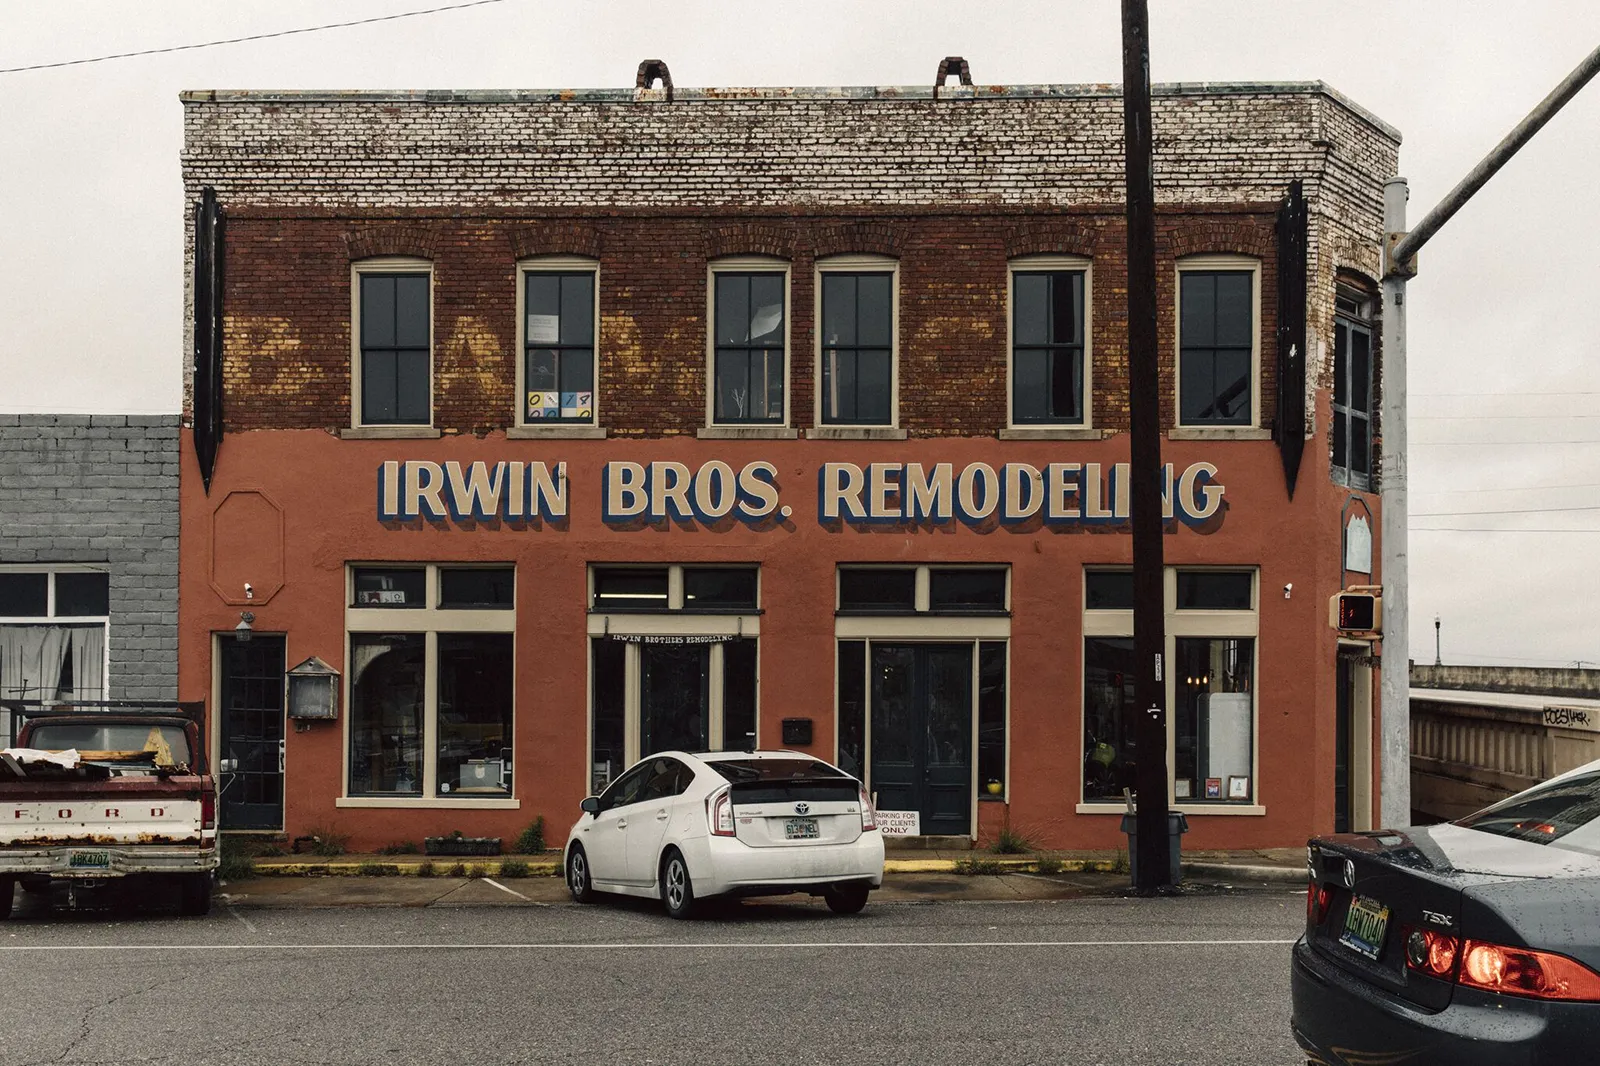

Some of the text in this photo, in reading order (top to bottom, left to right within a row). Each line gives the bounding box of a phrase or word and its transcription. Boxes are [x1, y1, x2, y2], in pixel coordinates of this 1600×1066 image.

[378, 460, 569, 523] IRWIN
[602, 459, 794, 526] BROS.
[612, 634, 734, 644] IRWIN BROTHERS REMODELING
[14, 808, 165, 819] FORD
[890, 819, 916, 827] CLIENTS
[881, 826, 909, 834] ONLY
[1422, 909, 1453, 927] TSX
